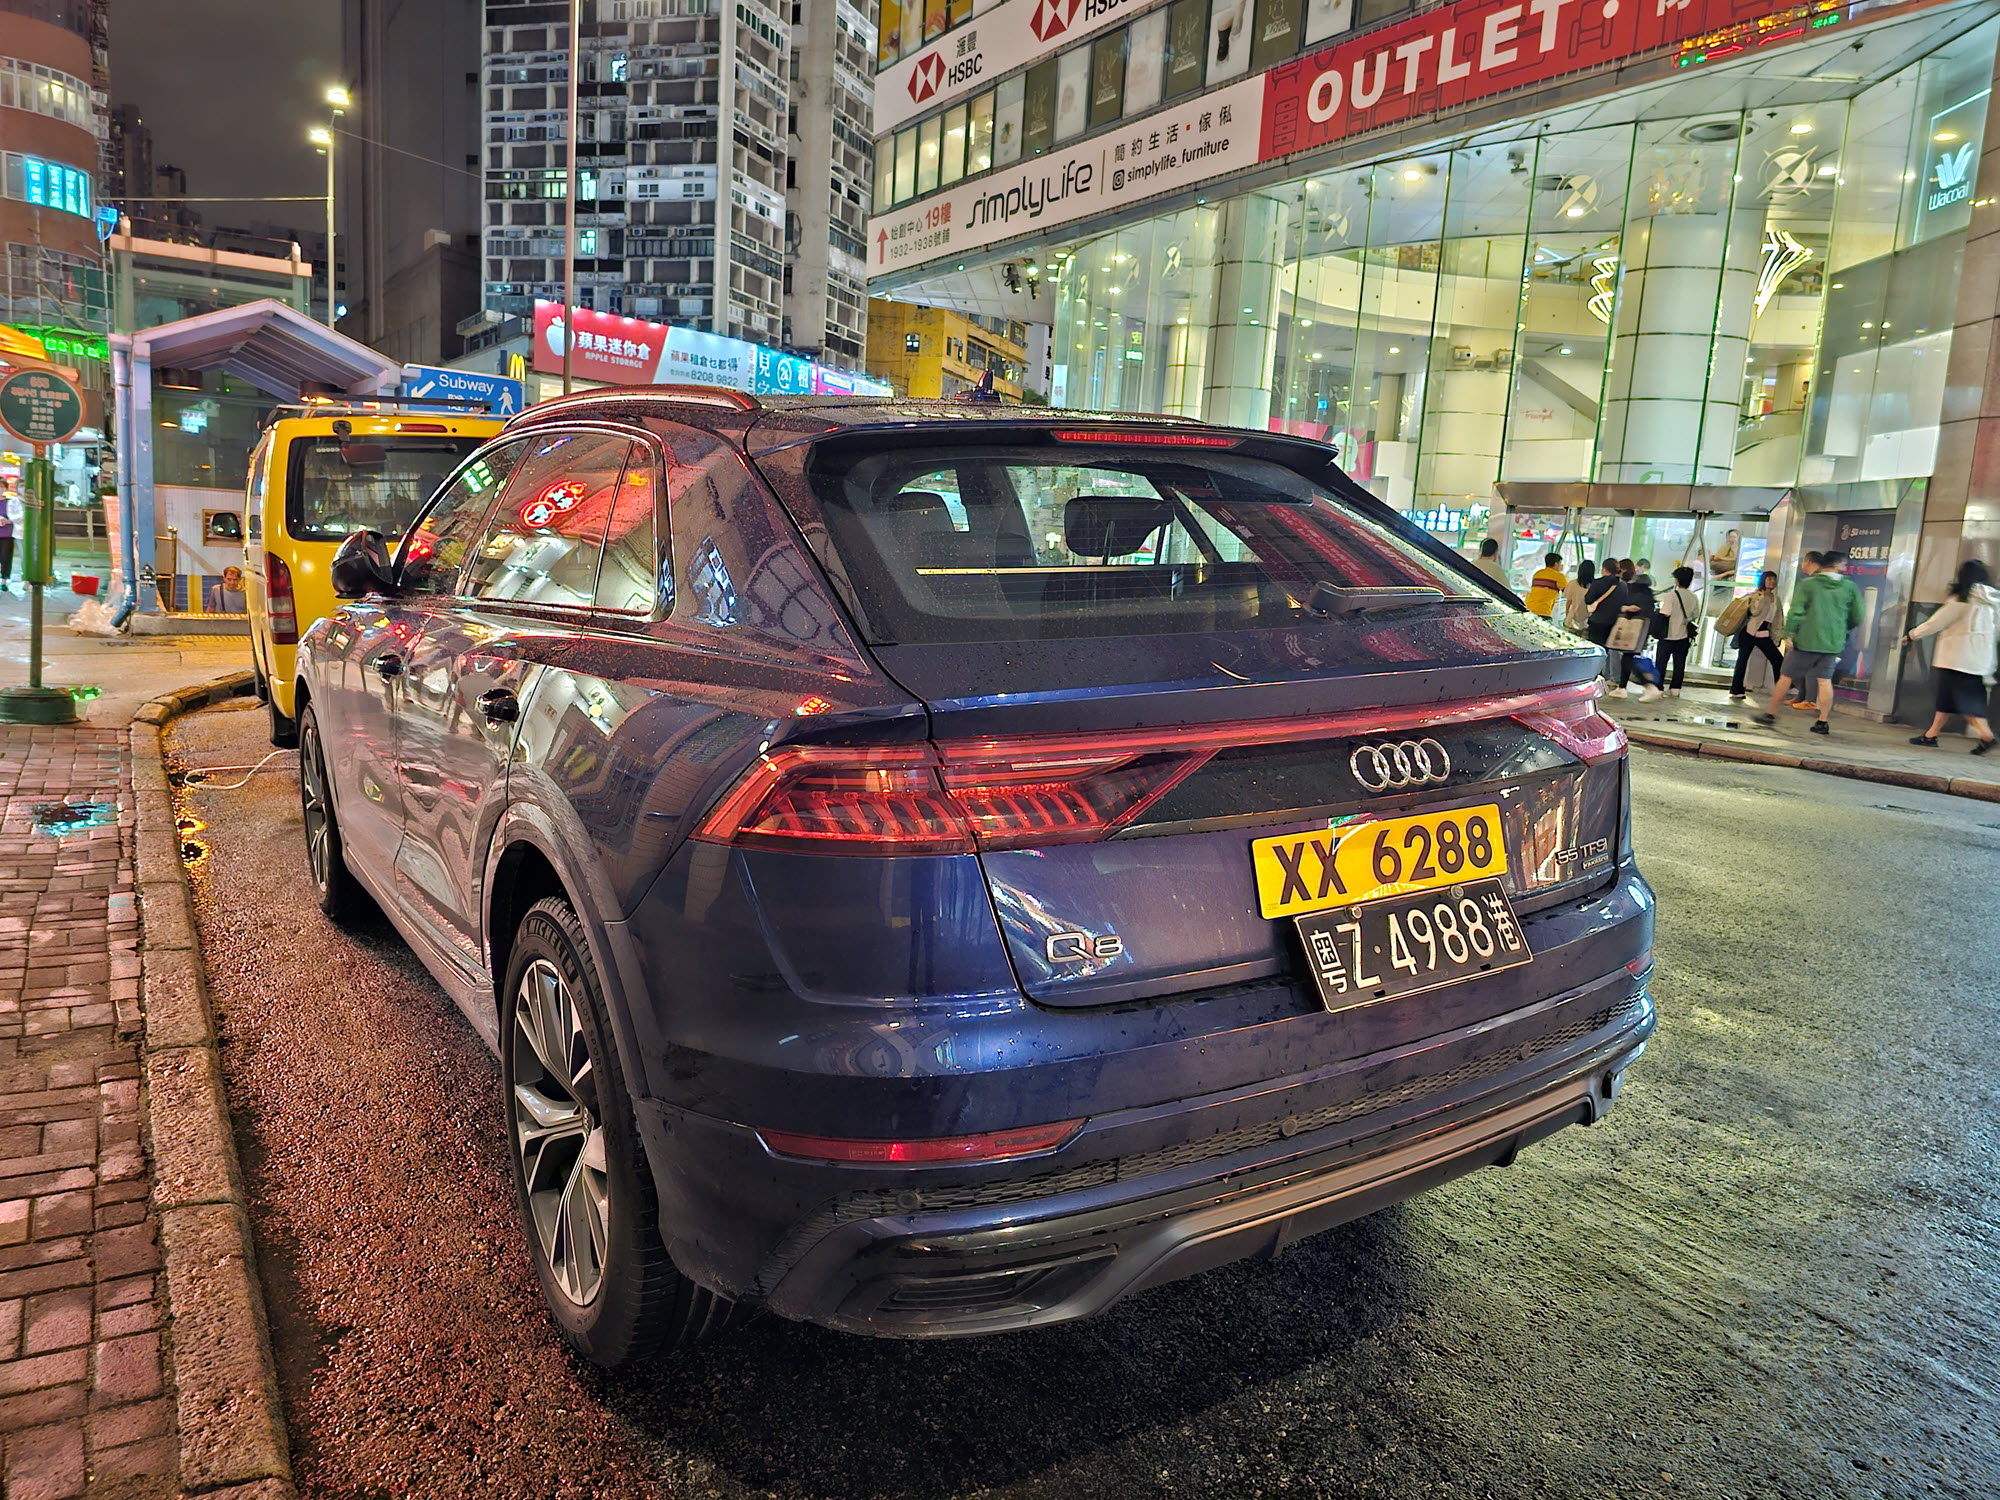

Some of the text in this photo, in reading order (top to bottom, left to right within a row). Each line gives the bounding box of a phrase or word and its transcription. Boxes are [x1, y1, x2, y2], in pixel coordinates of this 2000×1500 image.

[1085, 0, 1127, 21] HS
[948, 53, 983, 87] HSBC
[1307, 0, 1574, 124] OUTLET
[1127, 138, 1230, 182] simplylife_furniture
[925, 201, 952, 230] 19樓
[578, 331, 651, 361] 蘋果迷你倉
[585, 351, 643, 369] APPLE STORAGE
[438, 373, 494, 396] Subway
[690, 369, 714, 383] 8208
[716, 374, 739, 388] 9822
[1272, 815, 1493, 905] XX 6288
[1557, 837, 1608, 865] 55 TFSI
[528, 918, 579, 984] MICHELIN
[1046, 932, 1124, 964] Q8
[575, 989, 591, 1025] PILOT
